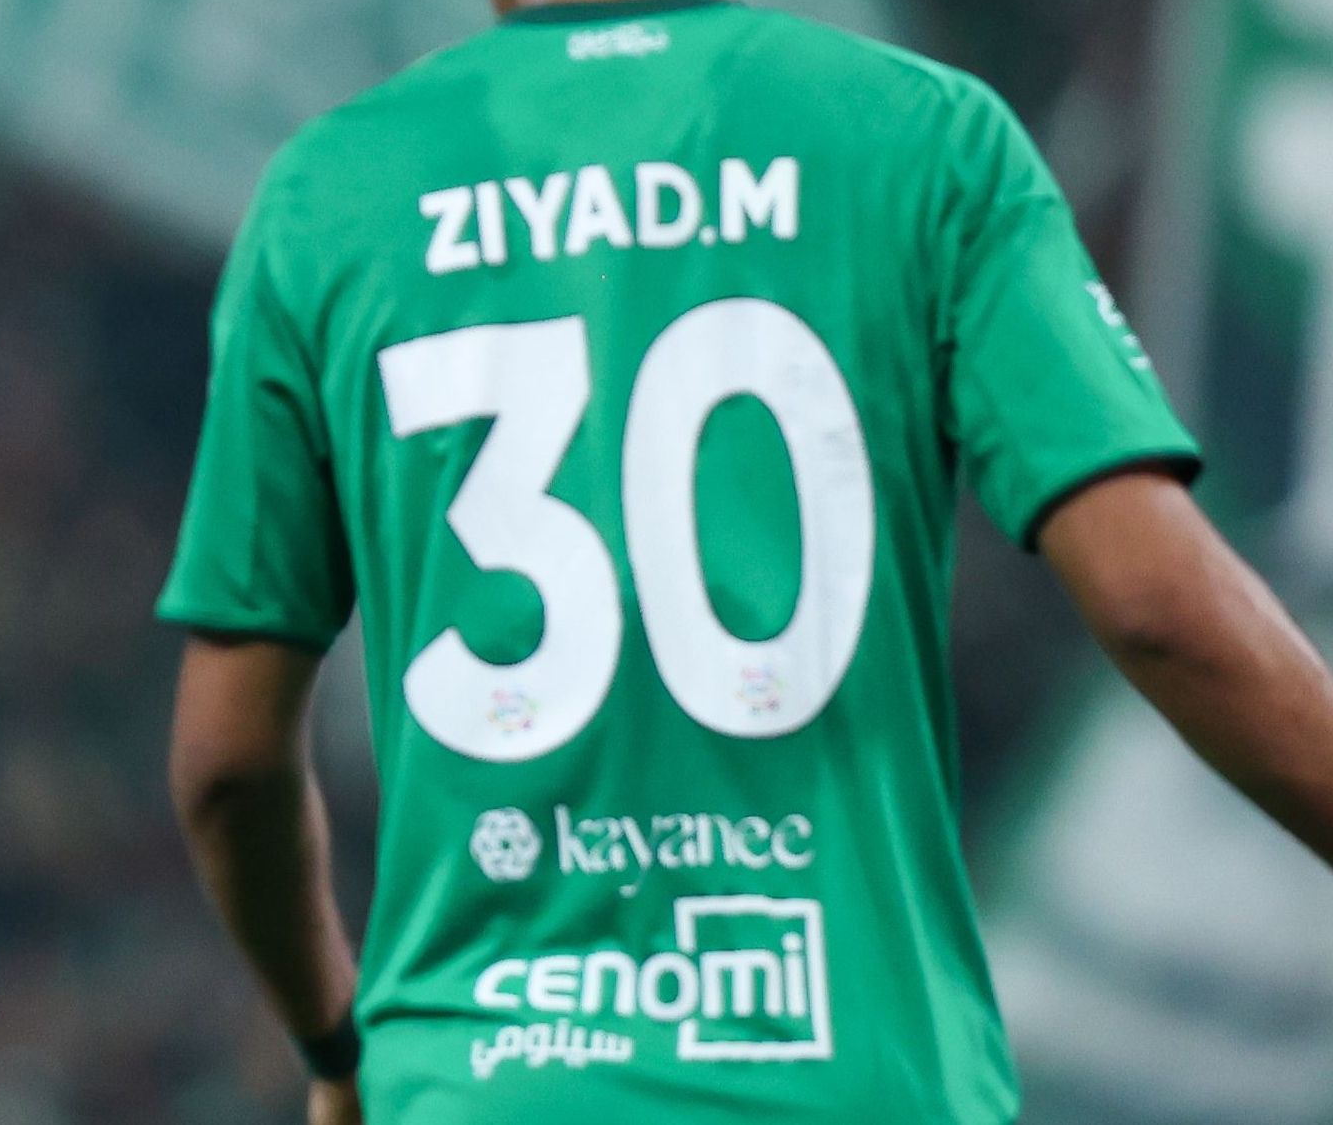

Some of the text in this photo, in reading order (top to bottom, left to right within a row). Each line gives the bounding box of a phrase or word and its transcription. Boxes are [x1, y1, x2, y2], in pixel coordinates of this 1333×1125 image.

[418, 156, 801, 275] ZIYAD.M
[376, 296, 876, 763] 30
[554, 803, 814, 898] kayanee
